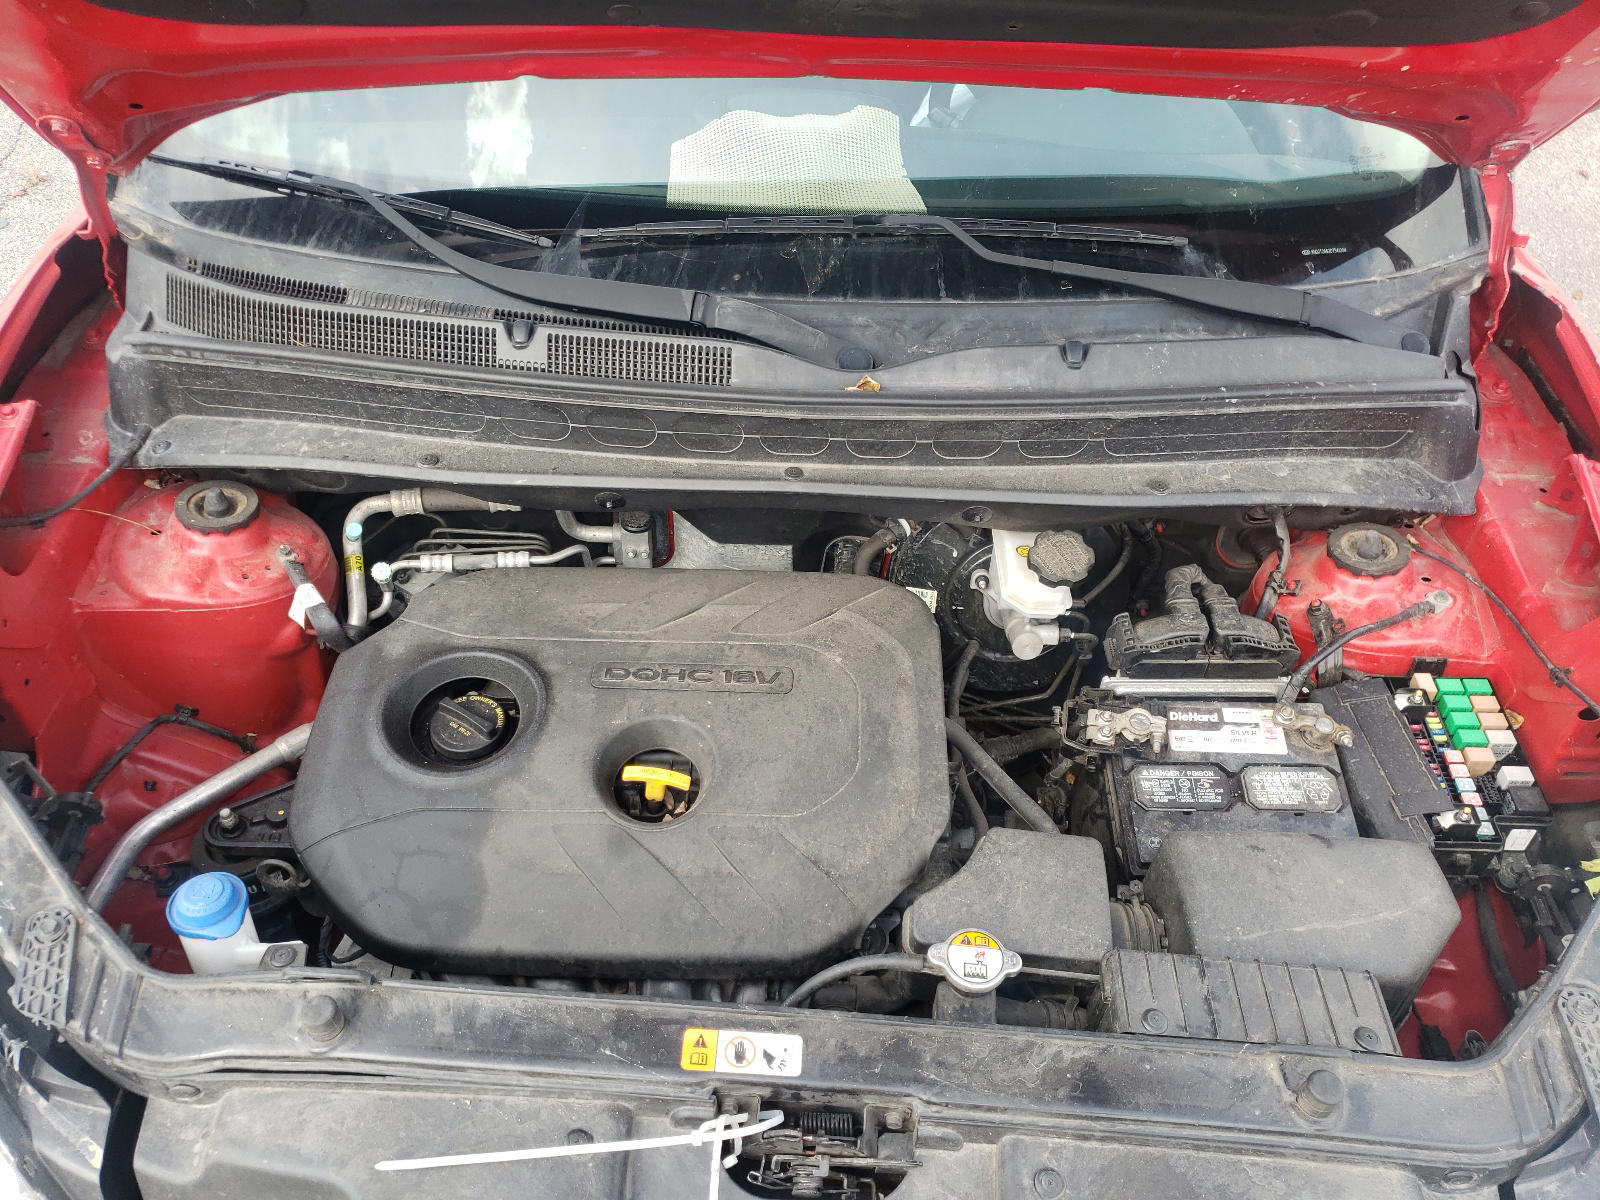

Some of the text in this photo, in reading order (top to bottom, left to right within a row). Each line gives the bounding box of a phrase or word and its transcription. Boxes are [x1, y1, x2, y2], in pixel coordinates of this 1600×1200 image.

[603, 667, 714, 683] DOHC
[469, 695, 497, 707] OWNER'S
[1169, 711, 1219, 722] DieHard
[1149, 769, 1180, 777] DANGER
